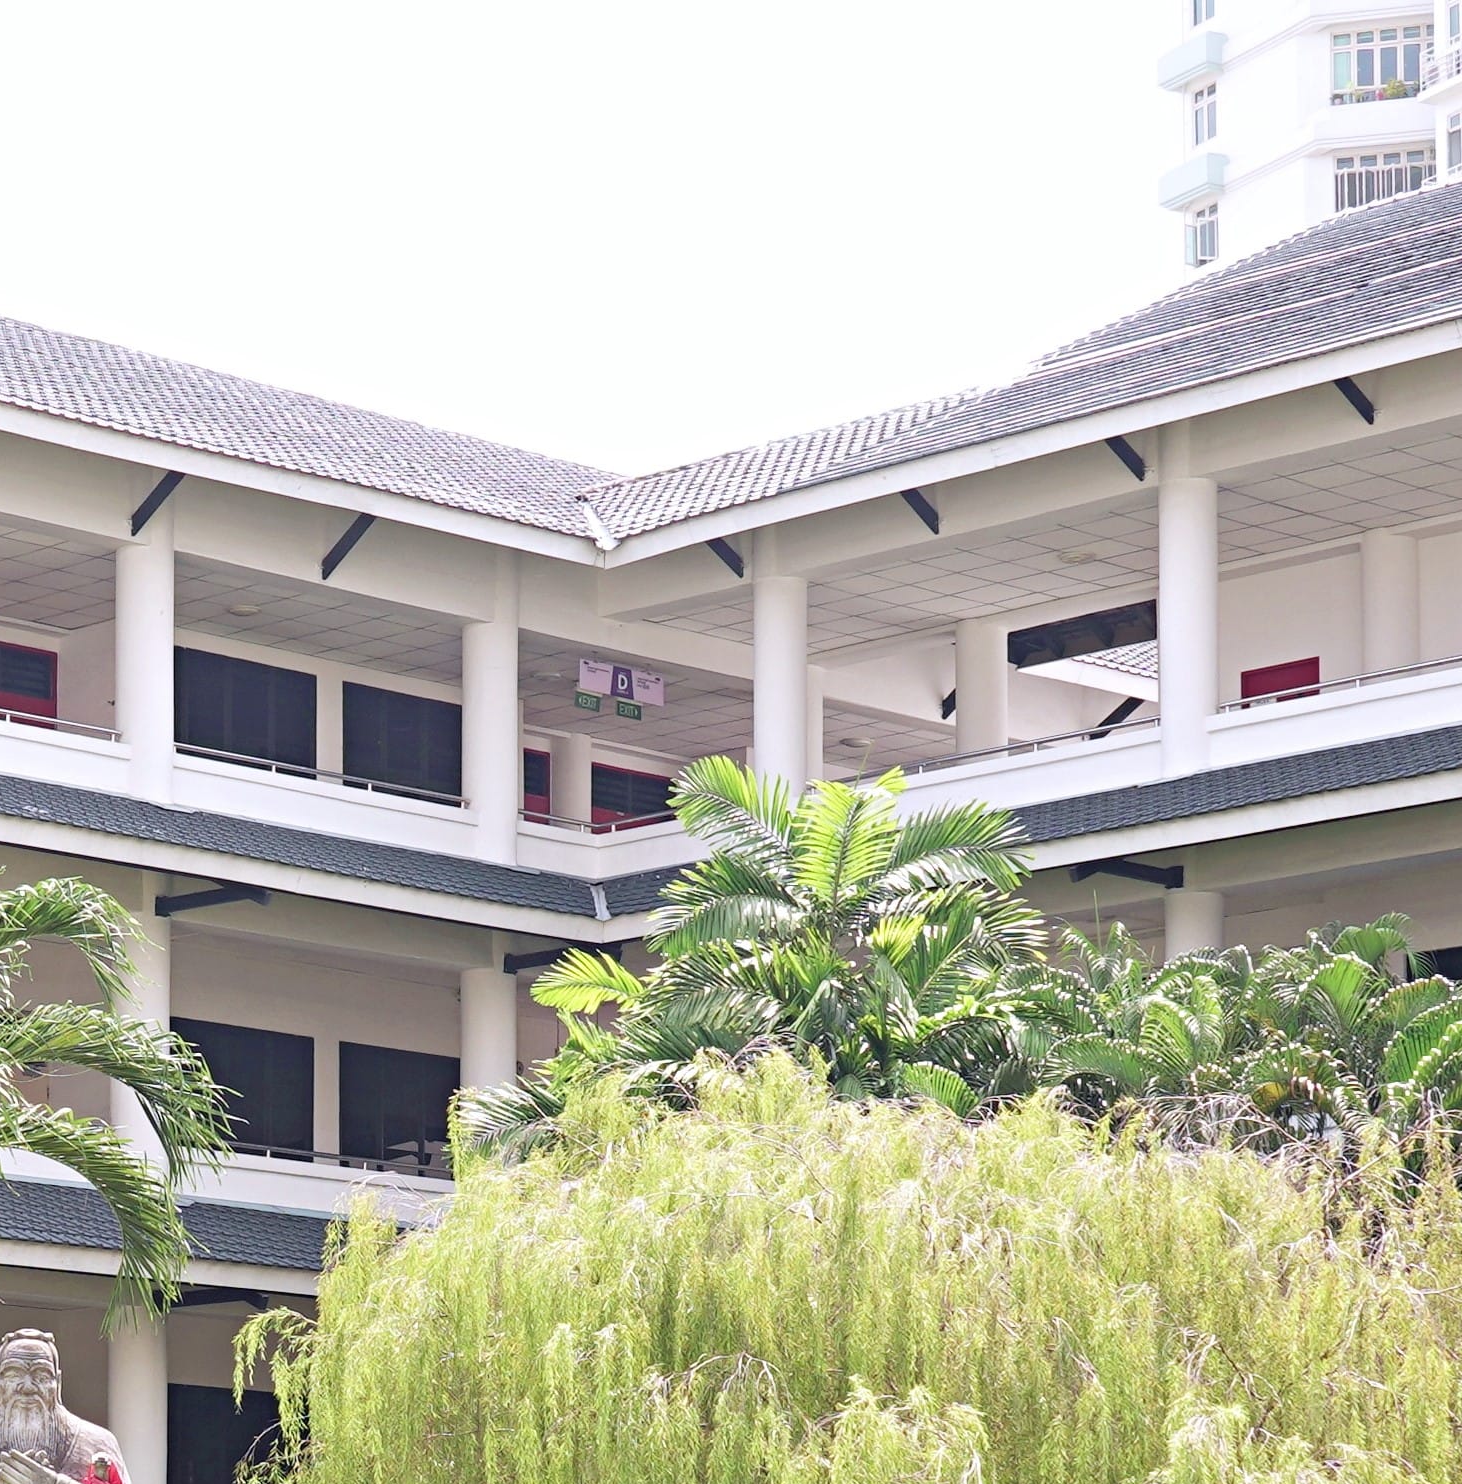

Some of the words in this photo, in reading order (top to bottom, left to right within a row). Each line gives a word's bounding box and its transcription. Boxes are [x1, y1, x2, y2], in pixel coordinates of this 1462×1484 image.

[617, 674, 628, 690] D
[582, 695, 597, 708] EXIT
[619, 704, 634, 717] EXIT
